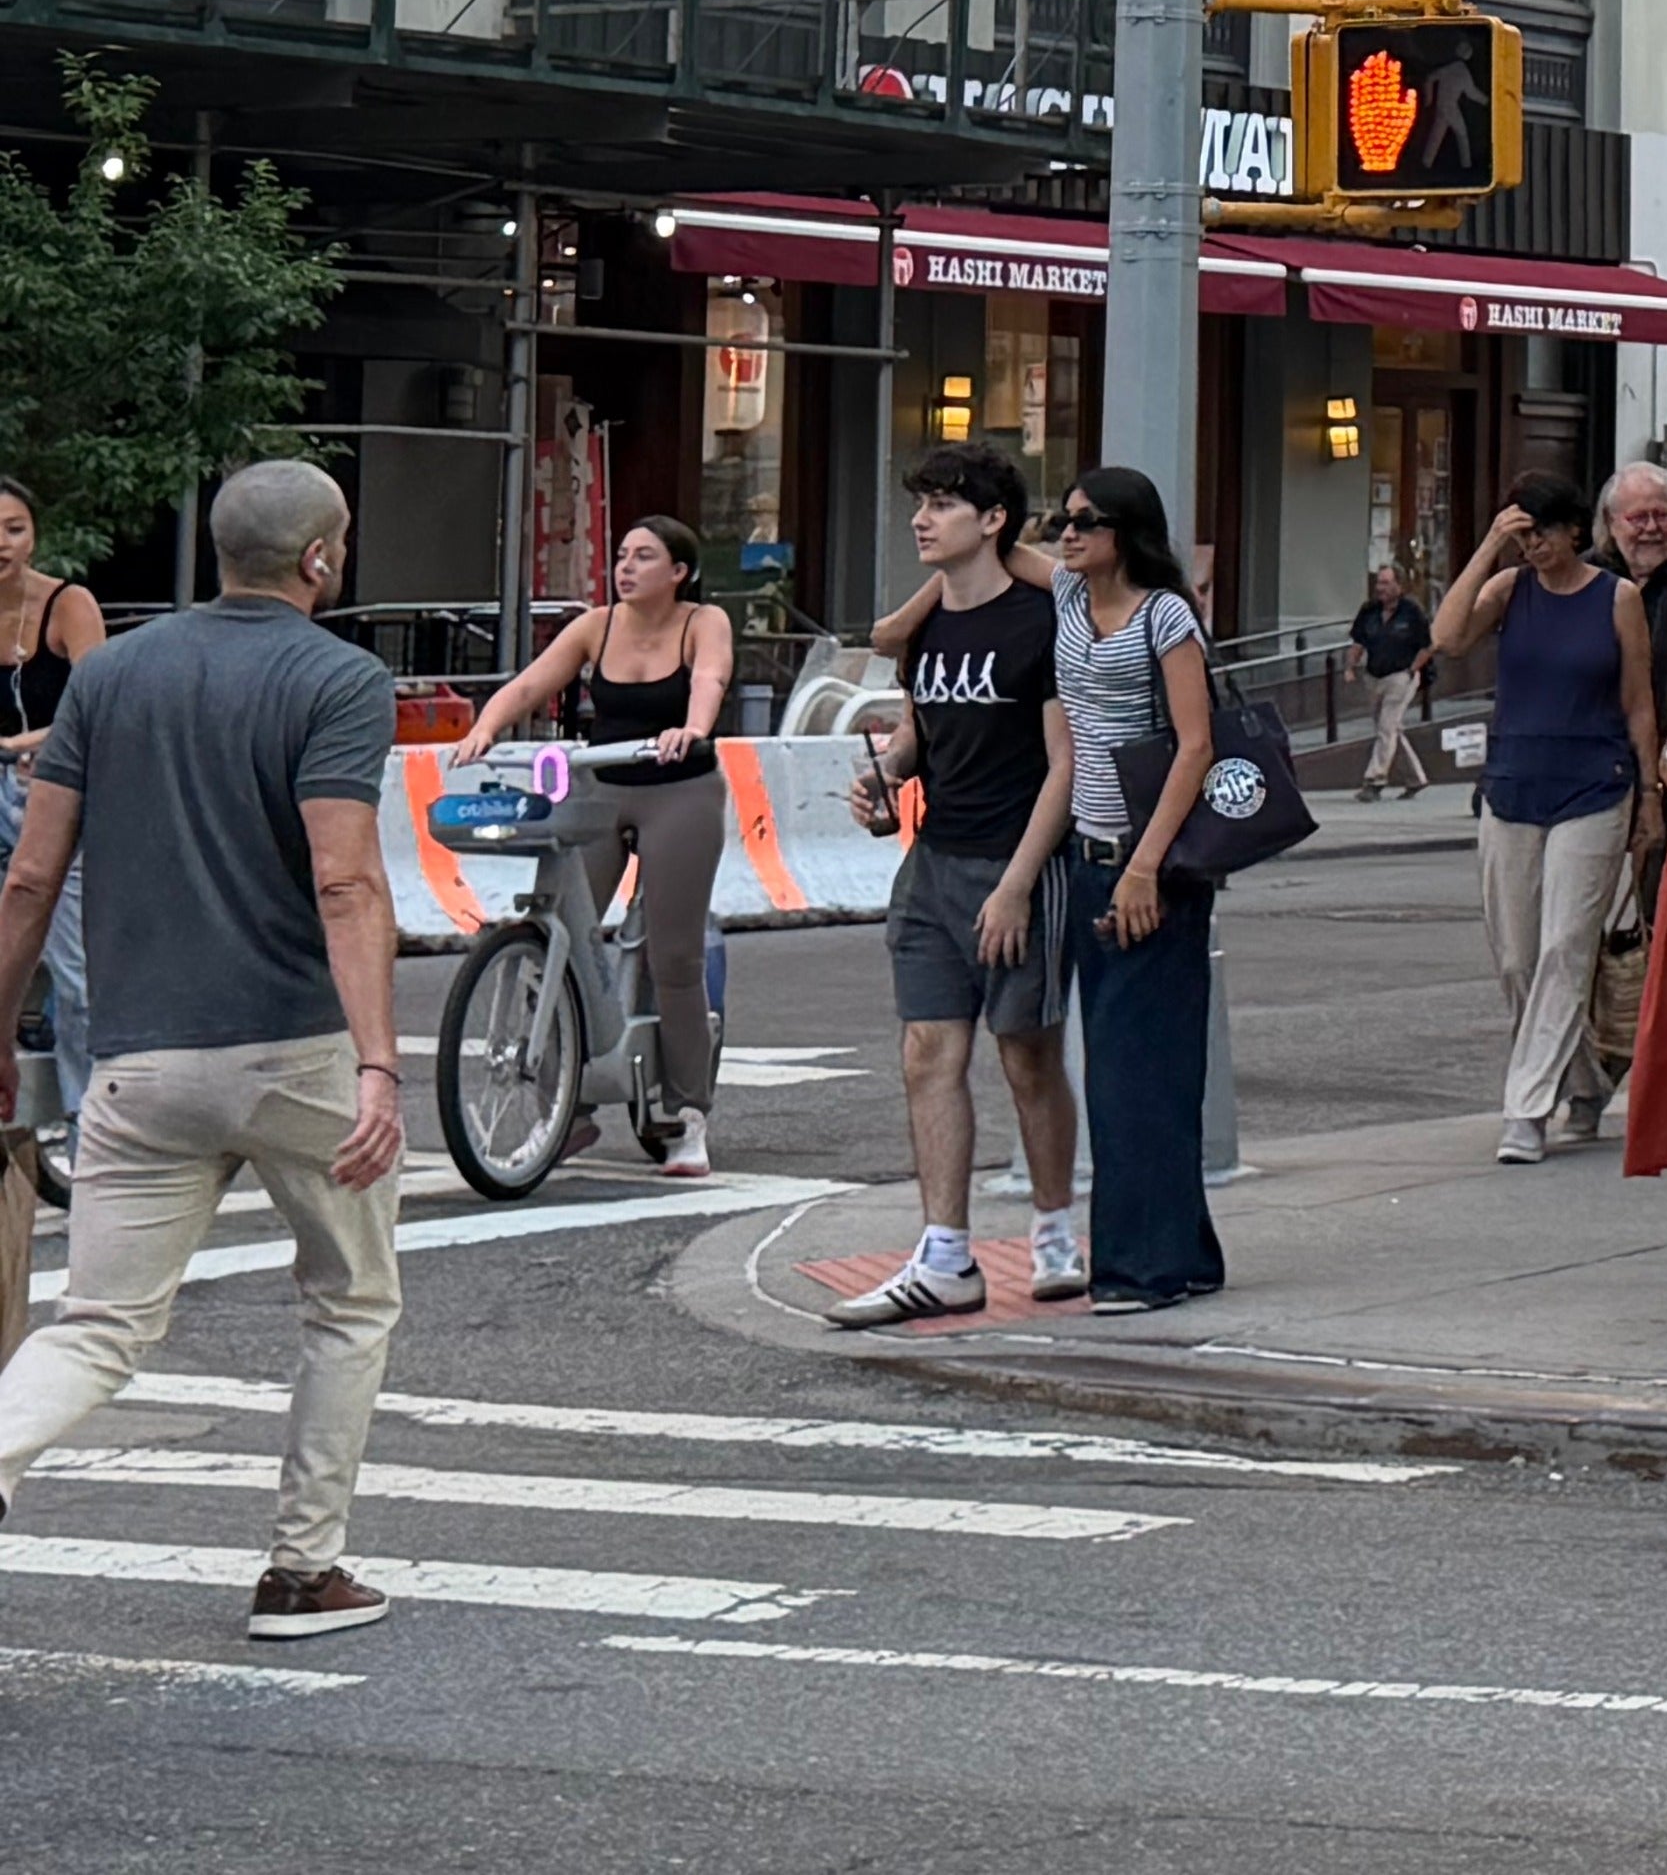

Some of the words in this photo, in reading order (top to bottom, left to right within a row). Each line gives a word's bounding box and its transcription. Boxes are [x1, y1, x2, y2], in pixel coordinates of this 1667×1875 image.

[927, 255, 1003, 287] HASHI
[1008, 262, 1107, 296] MARKET
[1487, 303, 1544, 329] HASHI
[1547, 307, 1623, 336] MARKET
